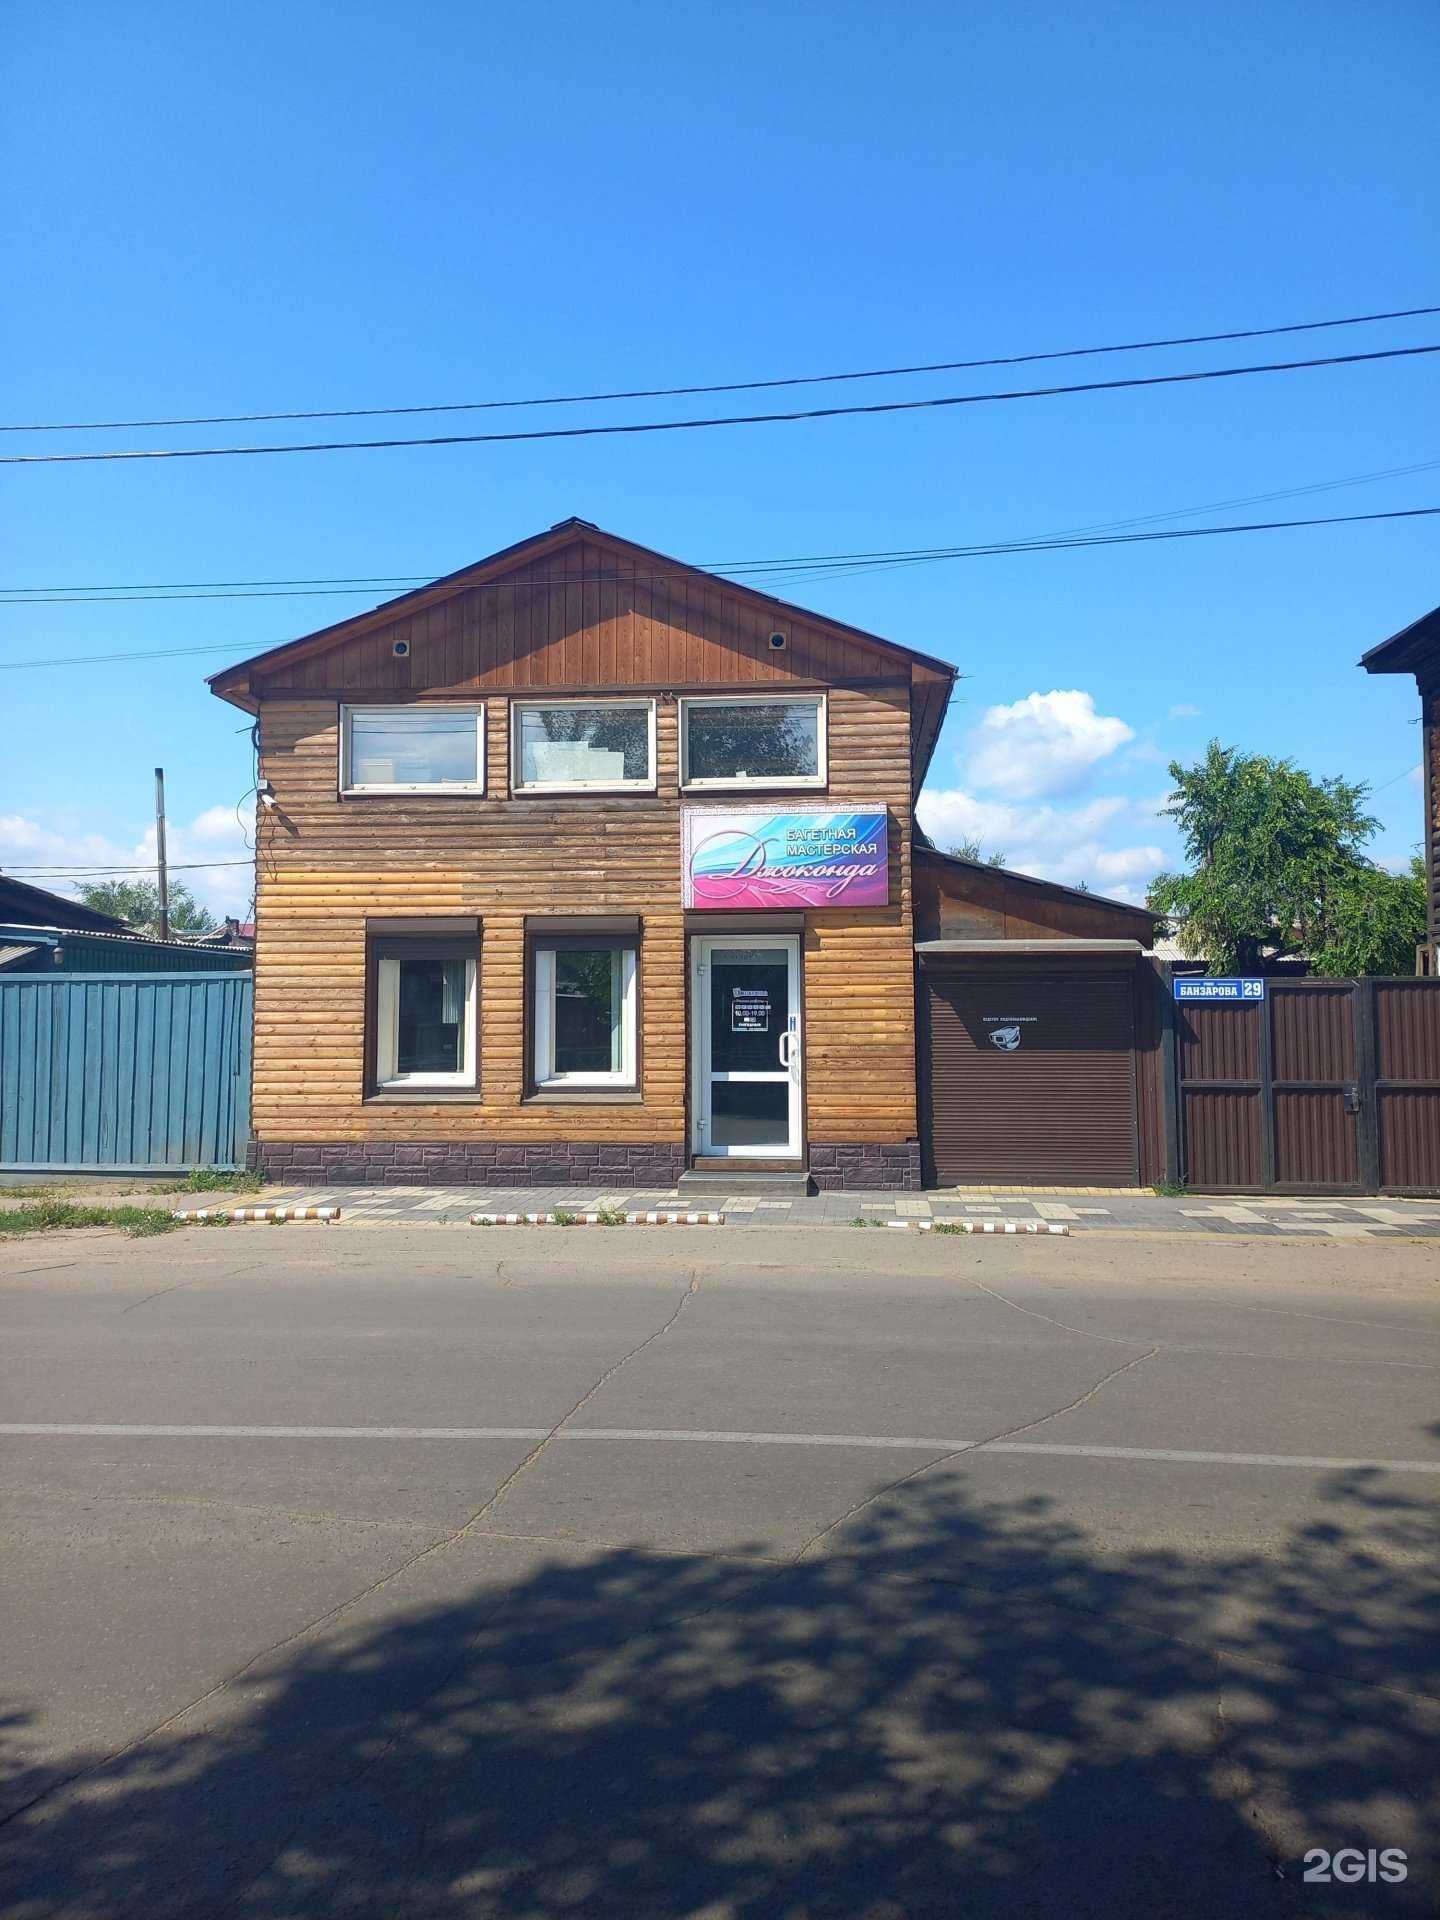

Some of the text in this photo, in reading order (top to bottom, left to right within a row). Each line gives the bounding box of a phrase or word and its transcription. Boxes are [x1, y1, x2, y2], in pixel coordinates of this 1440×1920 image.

[787, 828, 856, 841] БАГЕТНАЯ
[787, 843, 877, 856] МАСТЕРСКАЯ
[690, 831, 879, 899] Джоконда
[1180, 982, 1261, 996] БАНЗАРОВА 29
